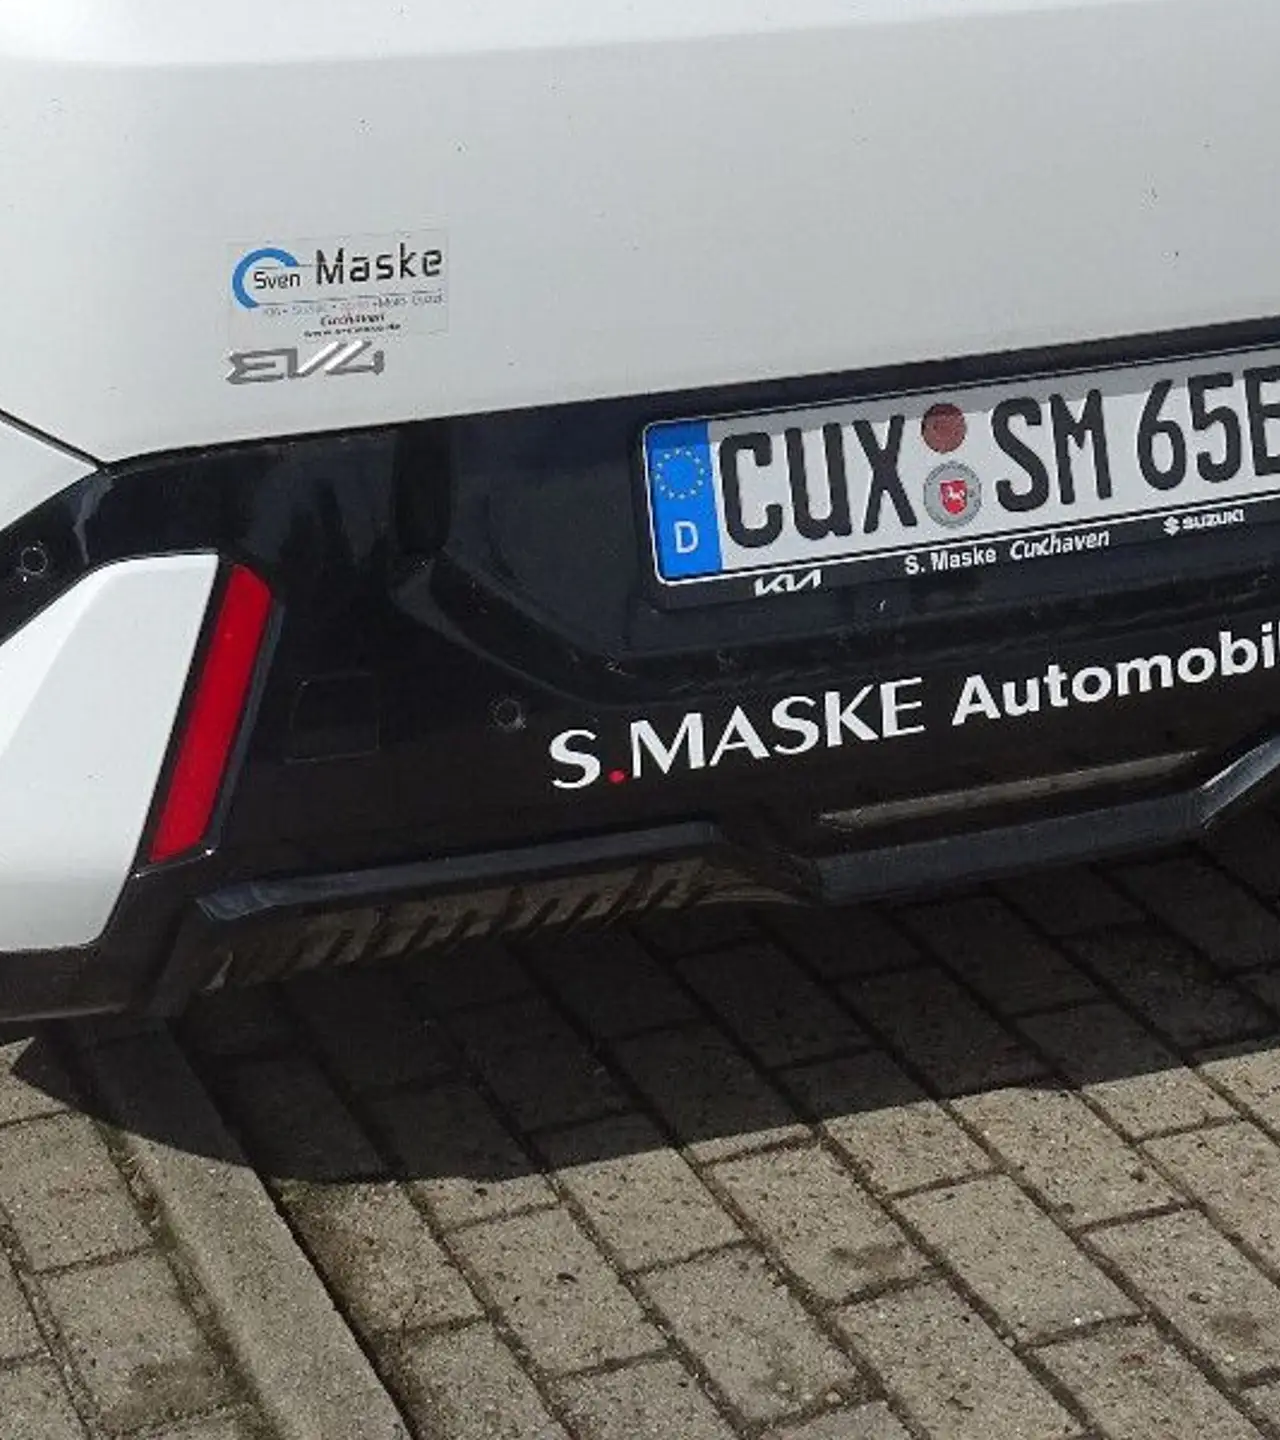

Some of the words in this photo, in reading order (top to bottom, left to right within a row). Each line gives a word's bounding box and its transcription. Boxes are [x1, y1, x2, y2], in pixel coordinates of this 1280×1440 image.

[253, 268, 301, 291] Sven
[315, 243, 443, 286] Maske
[674, 519, 699, 555] D
[717, 414, 918, 550] CUX
[989, 387, 1113, 514] SM
[1182, 508, 1246, 530] SUZUKI
[904, 550, 928, 576] S.
[930, 544, 998, 573] Maske
[1009, 529, 1111, 563] Cuxhaven
